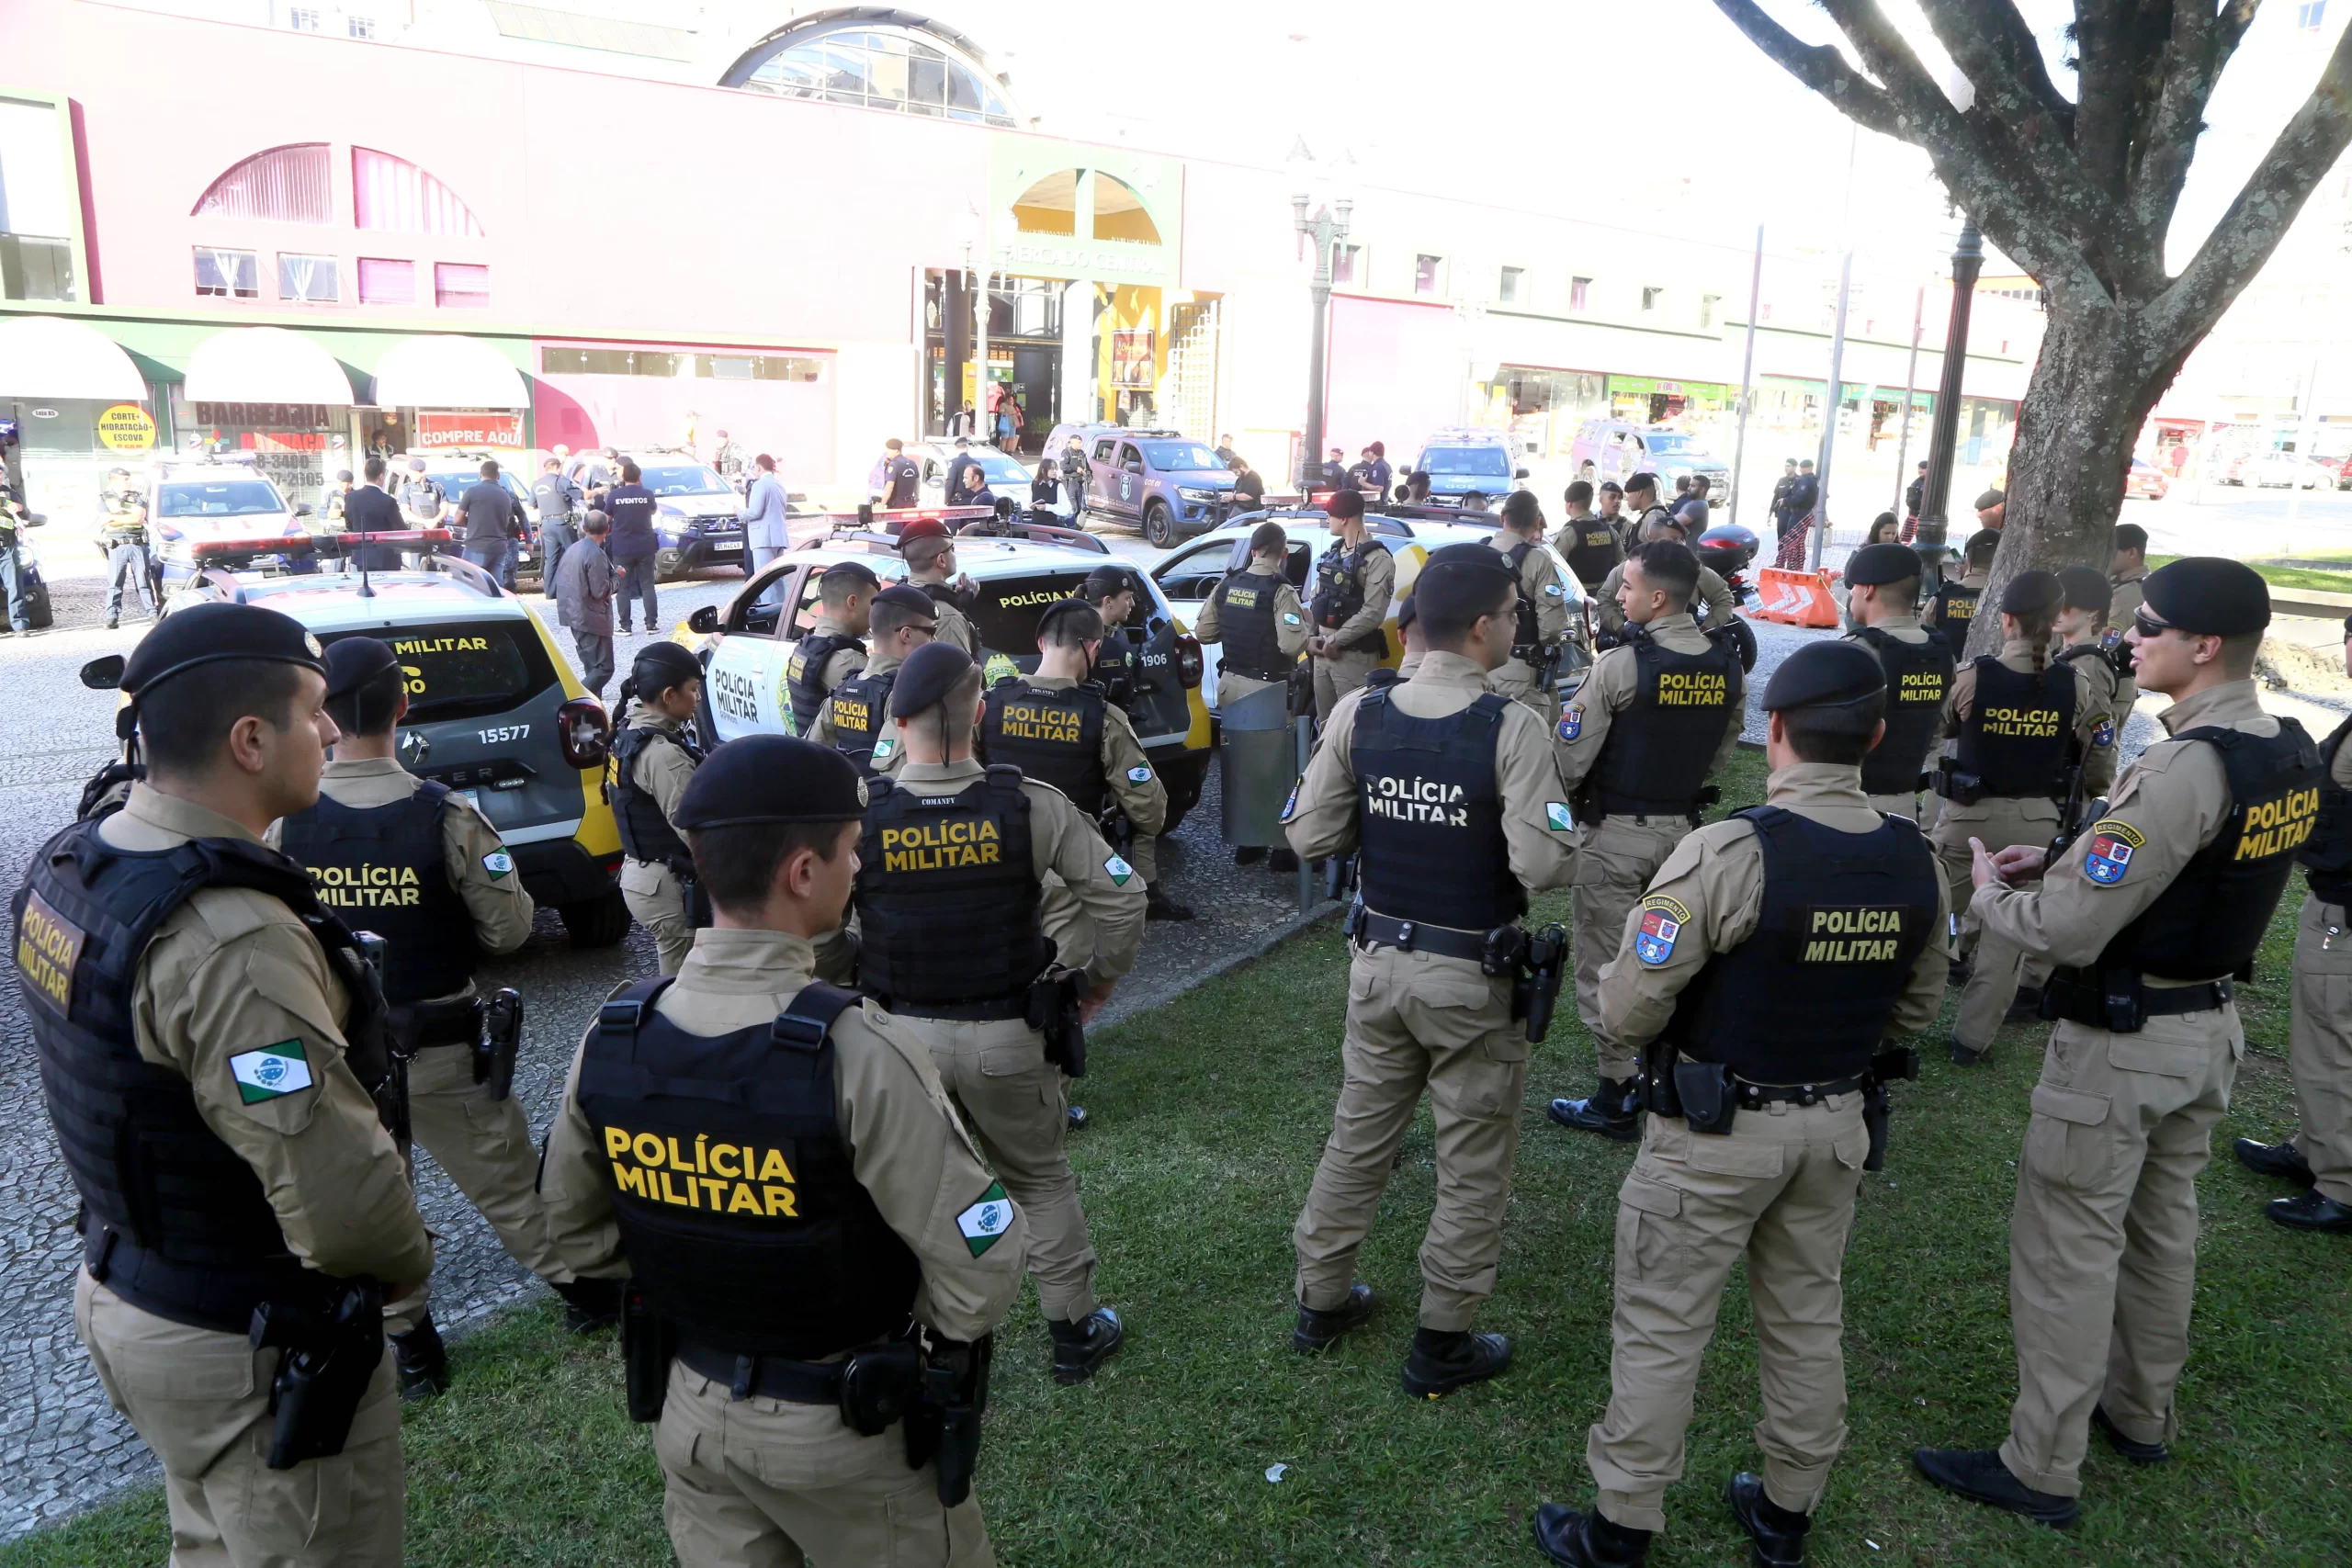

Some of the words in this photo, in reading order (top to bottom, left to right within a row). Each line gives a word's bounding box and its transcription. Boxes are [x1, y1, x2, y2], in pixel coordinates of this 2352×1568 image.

[114, 434, 143, 442] ESCOVA
[422, 430, 483, 446] COMPRE
[487, 430, 523, 446] AQUI
[616, 497, 648, 505] EVENTOS
[999, 591, 1064, 608] POLÍCIA
[1227, 596, 1254, 607] MILITAR
[1948, 598, 1977, 609] POLÍ
[1948, 609, 1976, 618] MILI
[395, 637, 488, 655] MILITAR
[716, 668, 756, 701] POLÍCIA
[1660, 671, 1725, 690] POLÍCIA
[1902, 671, 1942, 686] POLÍCIA
[1658, 690, 1724, 705] MILITAR
[1900, 690, 1941, 701] MILITAR
[717, 690, 760, 724] MILITAR
[834, 700, 868, 718] POLÍCIA
[1002, 705, 1081, 727] POLÍCIA
[833, 713, 868, 732] MILITAR
[1001, 721, 1080, 742] MILITAR
[1983, 722, 2058, 737] MILITAR
[478, 724, 530, 744] 15577
[1366, 775, 1469, 806] OLÍCIA
[922, 796, 956, 806] COMANFY
[1368, 795, 1468, 827] MILITAR
[2245, 787, 2320, 833] POLÍCIA
[882, 819, 1000, 850] POLÍCIA
[2098, 823, 2140, 843] REGIMENTO
[2233, 816, 2315, 861] MILITAR
[885, 842, 1001, 872] MILITAR
[314, 888, 420, 907] MILITAR
[1646, 898, 1686, 919] REGIMENTO
[1812, 908, 1901, 933] POLÍCIA
[22, 906, 75, 970] POLÍCIA
[1804, 940, 1897, 962] MILITAR
[17, 936, 69, 1005] MILITAR
[605, 1125, 796, 1184] POLÍCIA
[611, 1161, 799, 1217] MILITAR
